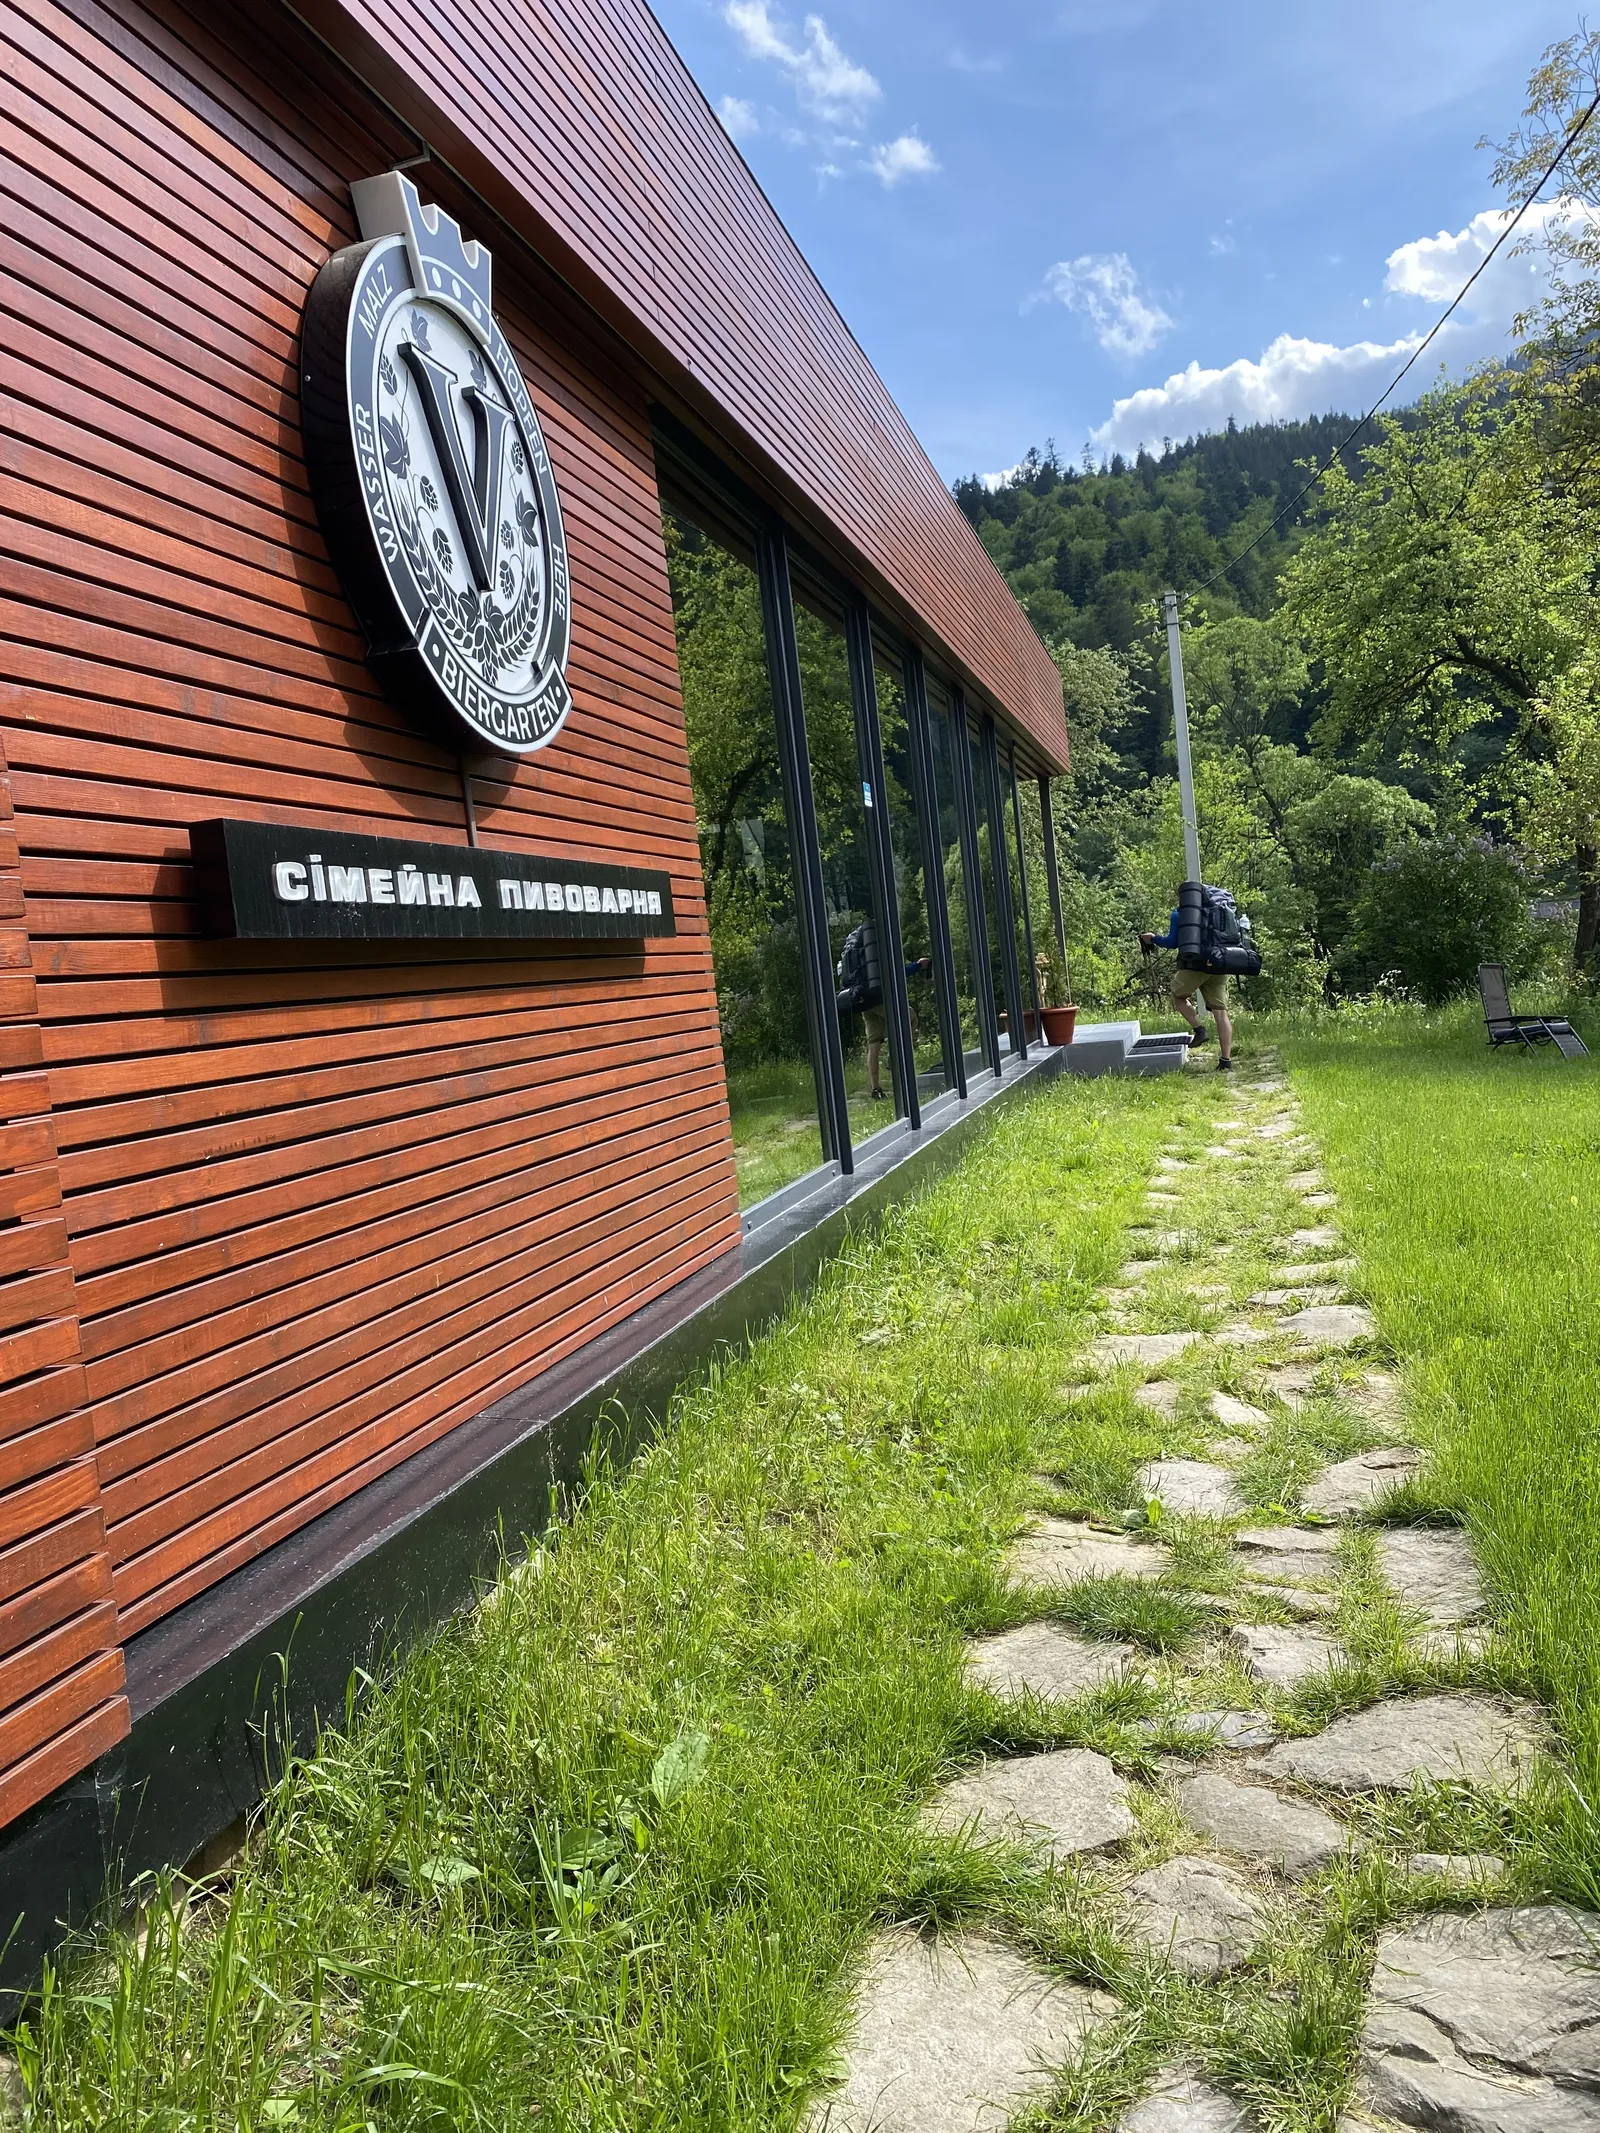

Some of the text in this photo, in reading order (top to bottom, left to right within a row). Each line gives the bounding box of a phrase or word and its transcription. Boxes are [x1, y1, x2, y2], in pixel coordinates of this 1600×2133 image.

[358, 263, 393, 340] MALZ
[496, 343, 548, 478] HOPFEN
[355, 403, 399, 563] WASSER
[552, 542, 566, 621] HEFE
[441, 650, 561, 741] BIERGARTEN
[498, 878, 662, 916] ПИВОВАРНЯ
